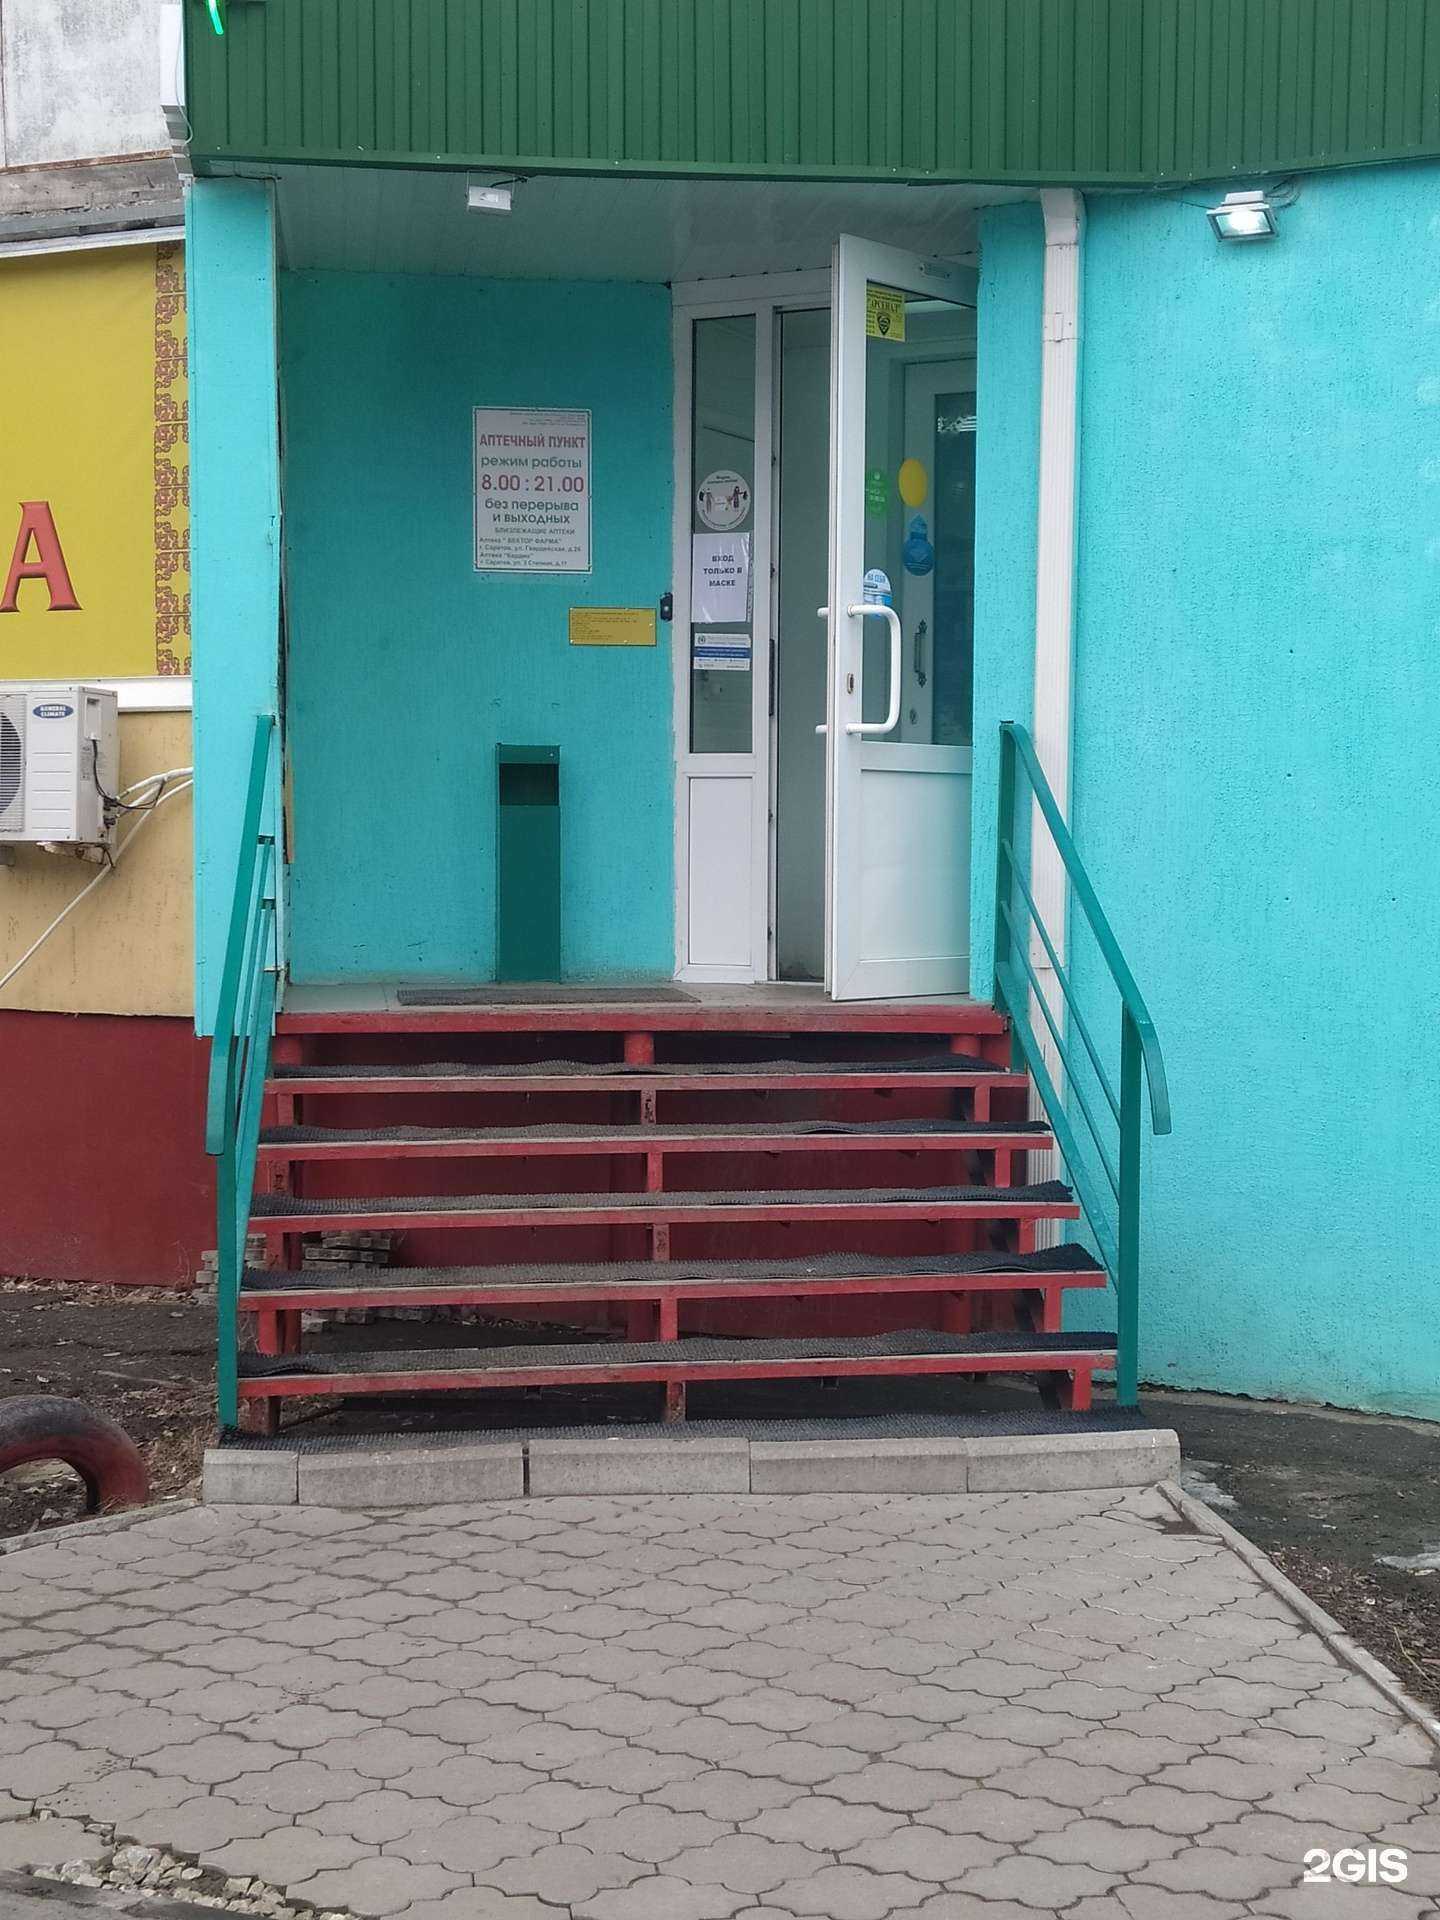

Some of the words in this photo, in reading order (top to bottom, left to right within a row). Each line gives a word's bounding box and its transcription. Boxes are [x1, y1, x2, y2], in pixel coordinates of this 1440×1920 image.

[480, 433, 545, 447] АПТЕЧНЫЙ
[549, 436, 586, 448] ПУНКТ
[481, 456, 529, 468] режим
[532, 457, 582, 469] работы
[482, 474, 521, 491] 8.00
[534, 475, 584, 492] 21.00
[485, 497, 508, 509] без
[511, 500, 579, 512] перерыва
[0, 501, 83, 612] А
